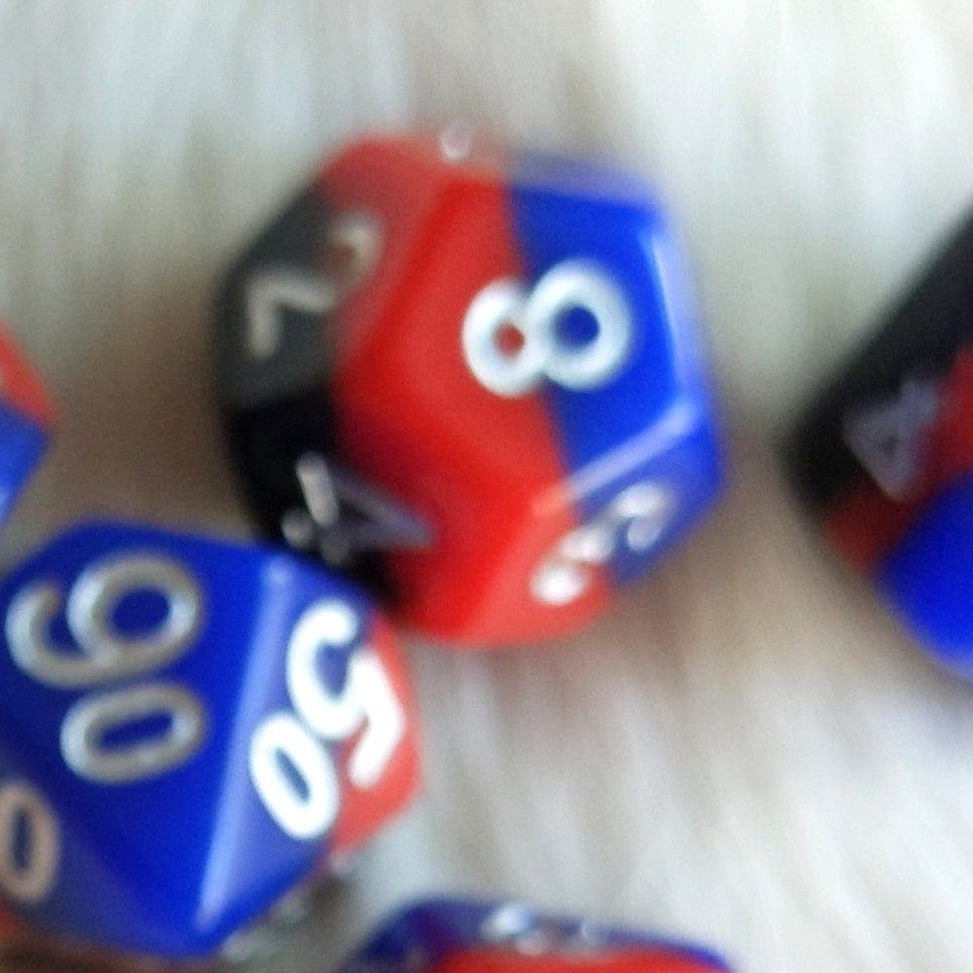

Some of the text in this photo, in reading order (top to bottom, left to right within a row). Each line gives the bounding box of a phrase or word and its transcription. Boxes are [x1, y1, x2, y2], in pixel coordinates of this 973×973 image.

[460, 255, 633, 398] 8
[3, 549, 207, 786] 90
[249, 598, 406, 841] 50
